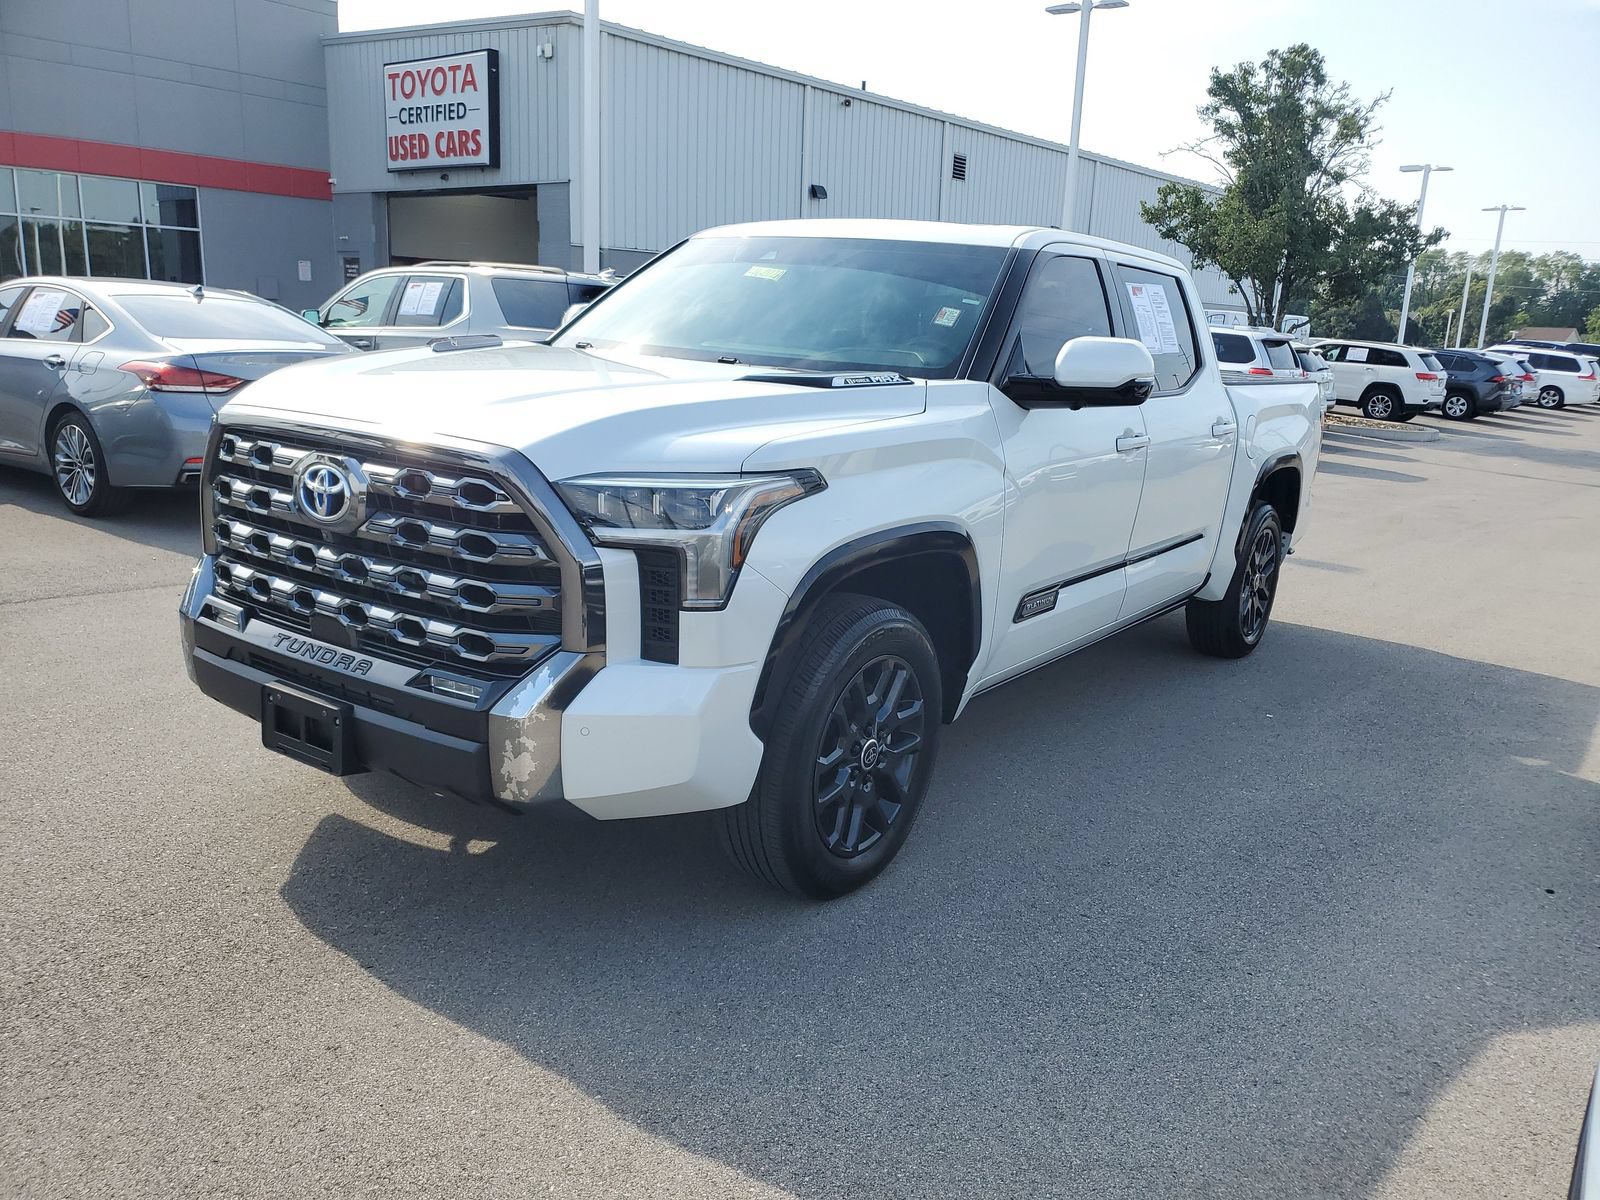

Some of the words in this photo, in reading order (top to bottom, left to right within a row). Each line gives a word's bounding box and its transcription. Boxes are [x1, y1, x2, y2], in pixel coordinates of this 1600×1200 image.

[388, 63, 478, 101] TOYOTA
[399, 102, 467, 125] CERTIFIED
[388, 133, 430, 161] USED
[435, 129, 482, 159] CARS
[1026, 595, 1055, 609] PLATINUM
[274, 632, 373, 676] TUNDRA
